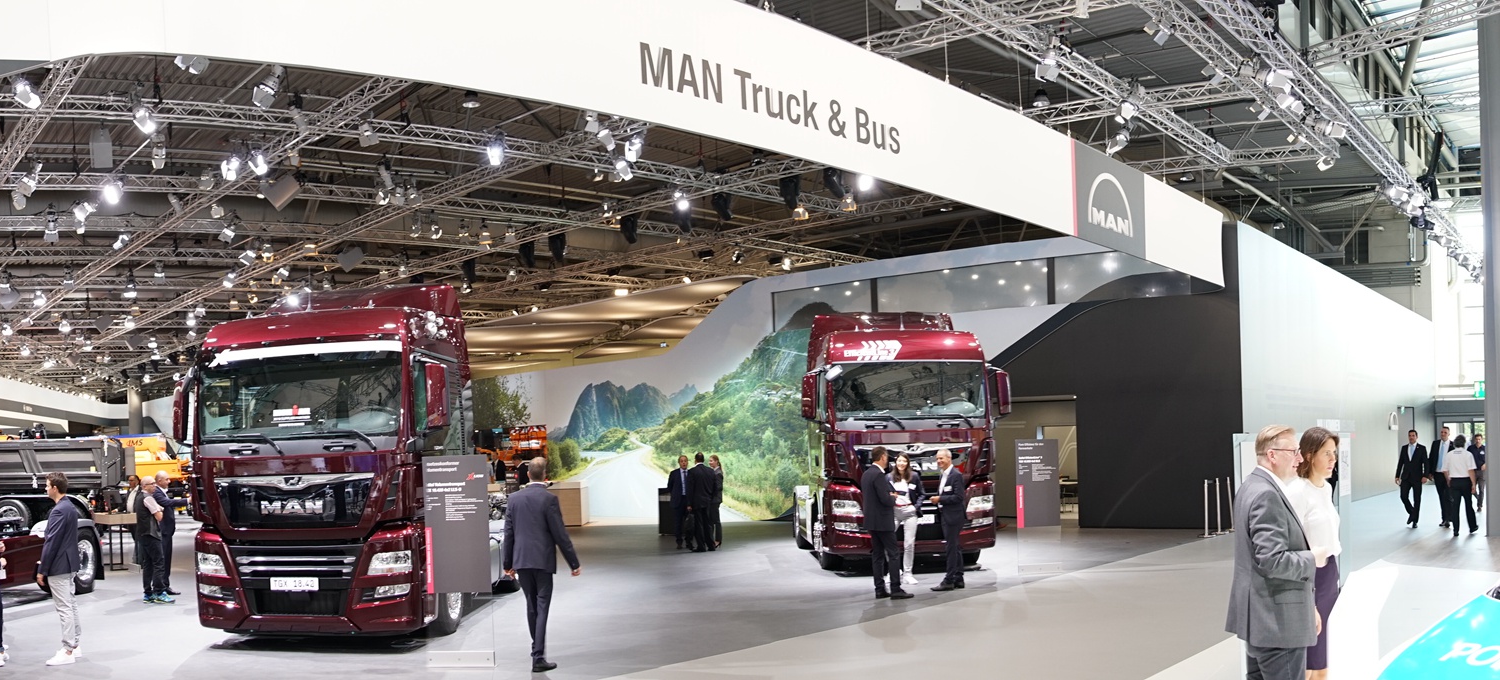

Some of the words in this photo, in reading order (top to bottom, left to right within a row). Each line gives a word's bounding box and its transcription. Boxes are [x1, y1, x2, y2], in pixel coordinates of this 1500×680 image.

[639, 41, 723, 104] MAN
[733, 68, 819, 132] Truck
[828, 99, 847, 138] &
[855, 107, 901, 155] Bus
[1092, 206, 1129, 236] MAN
[260, 499, 323, 515] MAN
[273, 579, 288, 588] TGX
